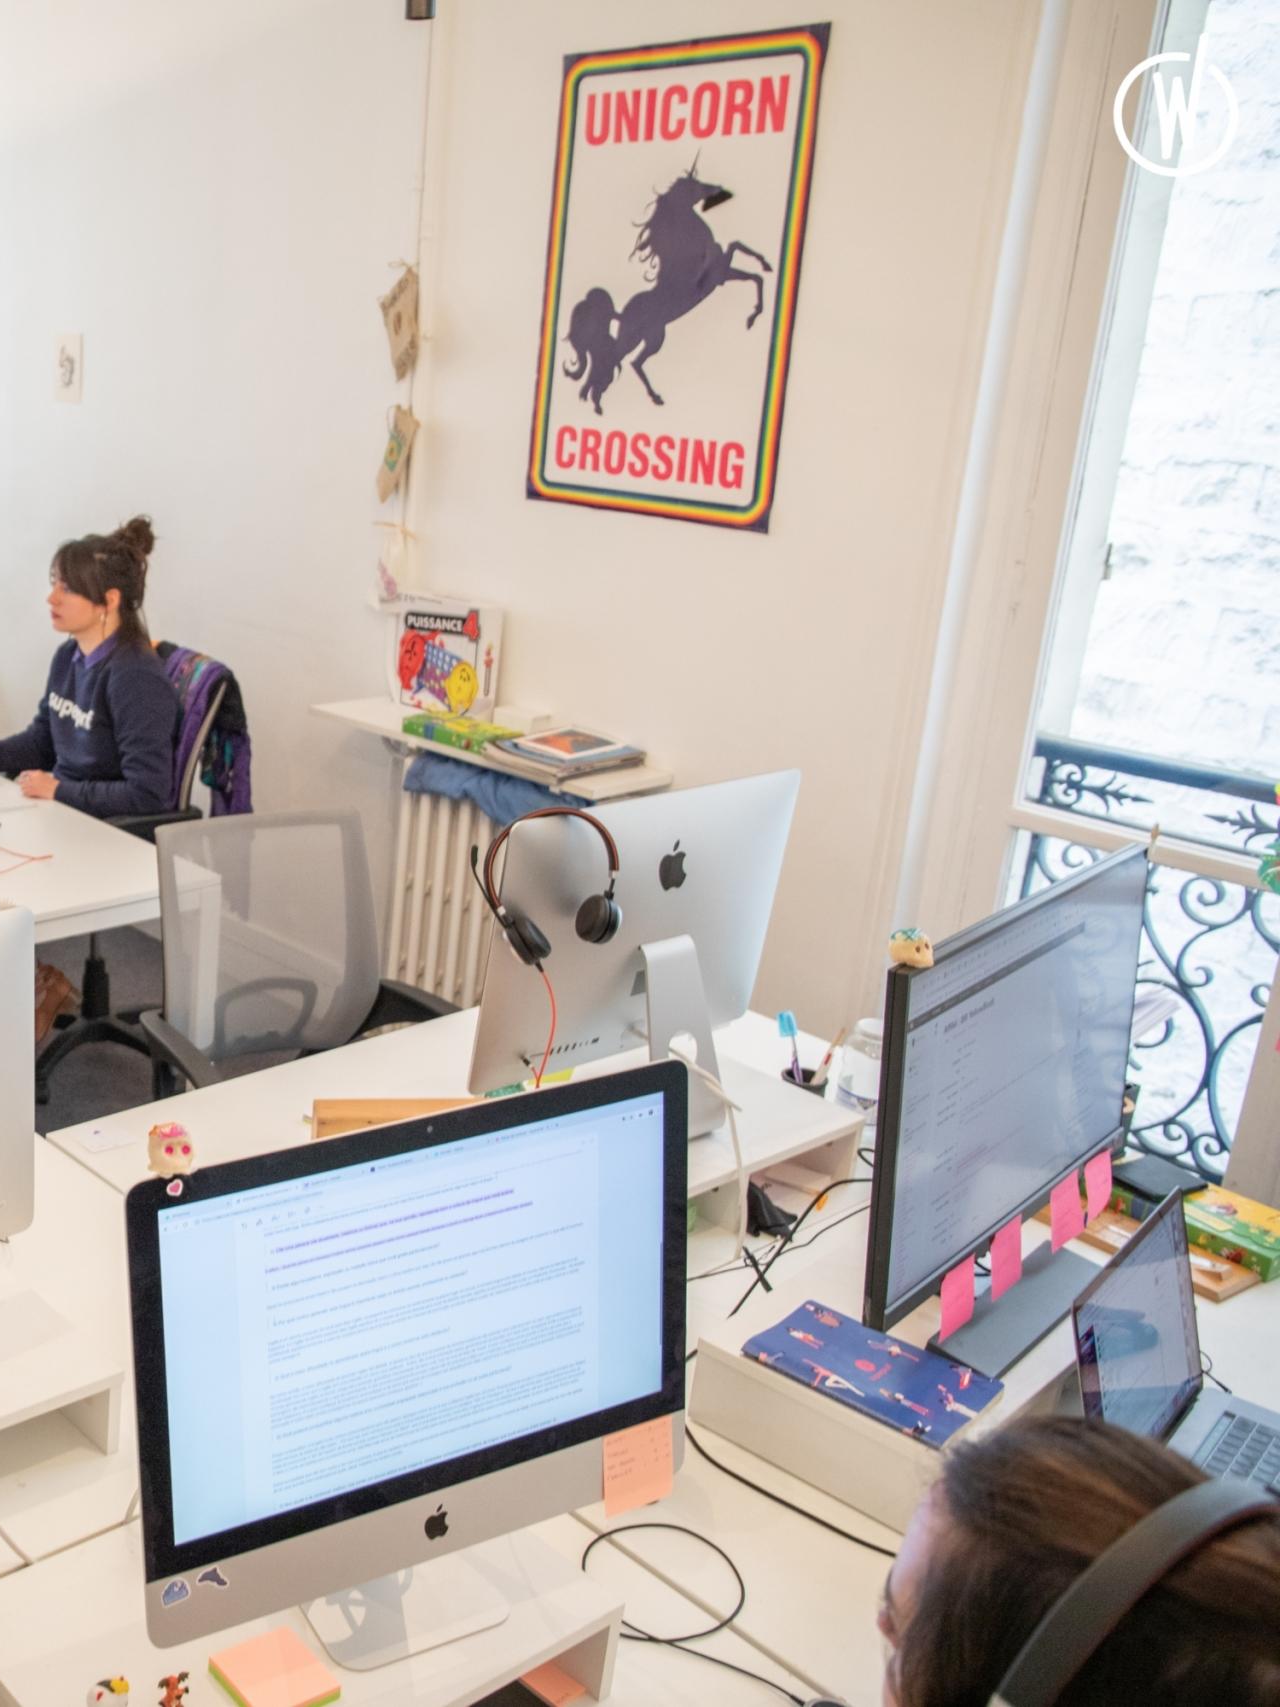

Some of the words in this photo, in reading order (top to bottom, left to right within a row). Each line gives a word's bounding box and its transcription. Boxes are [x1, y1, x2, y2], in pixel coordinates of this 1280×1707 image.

[584, 74, 790, 146] UNICORN
[555, 425, 746, 490] CROSSING
[407, 615, 463, 632] PUISSANCE
[463, 612, 479, 639] 4
